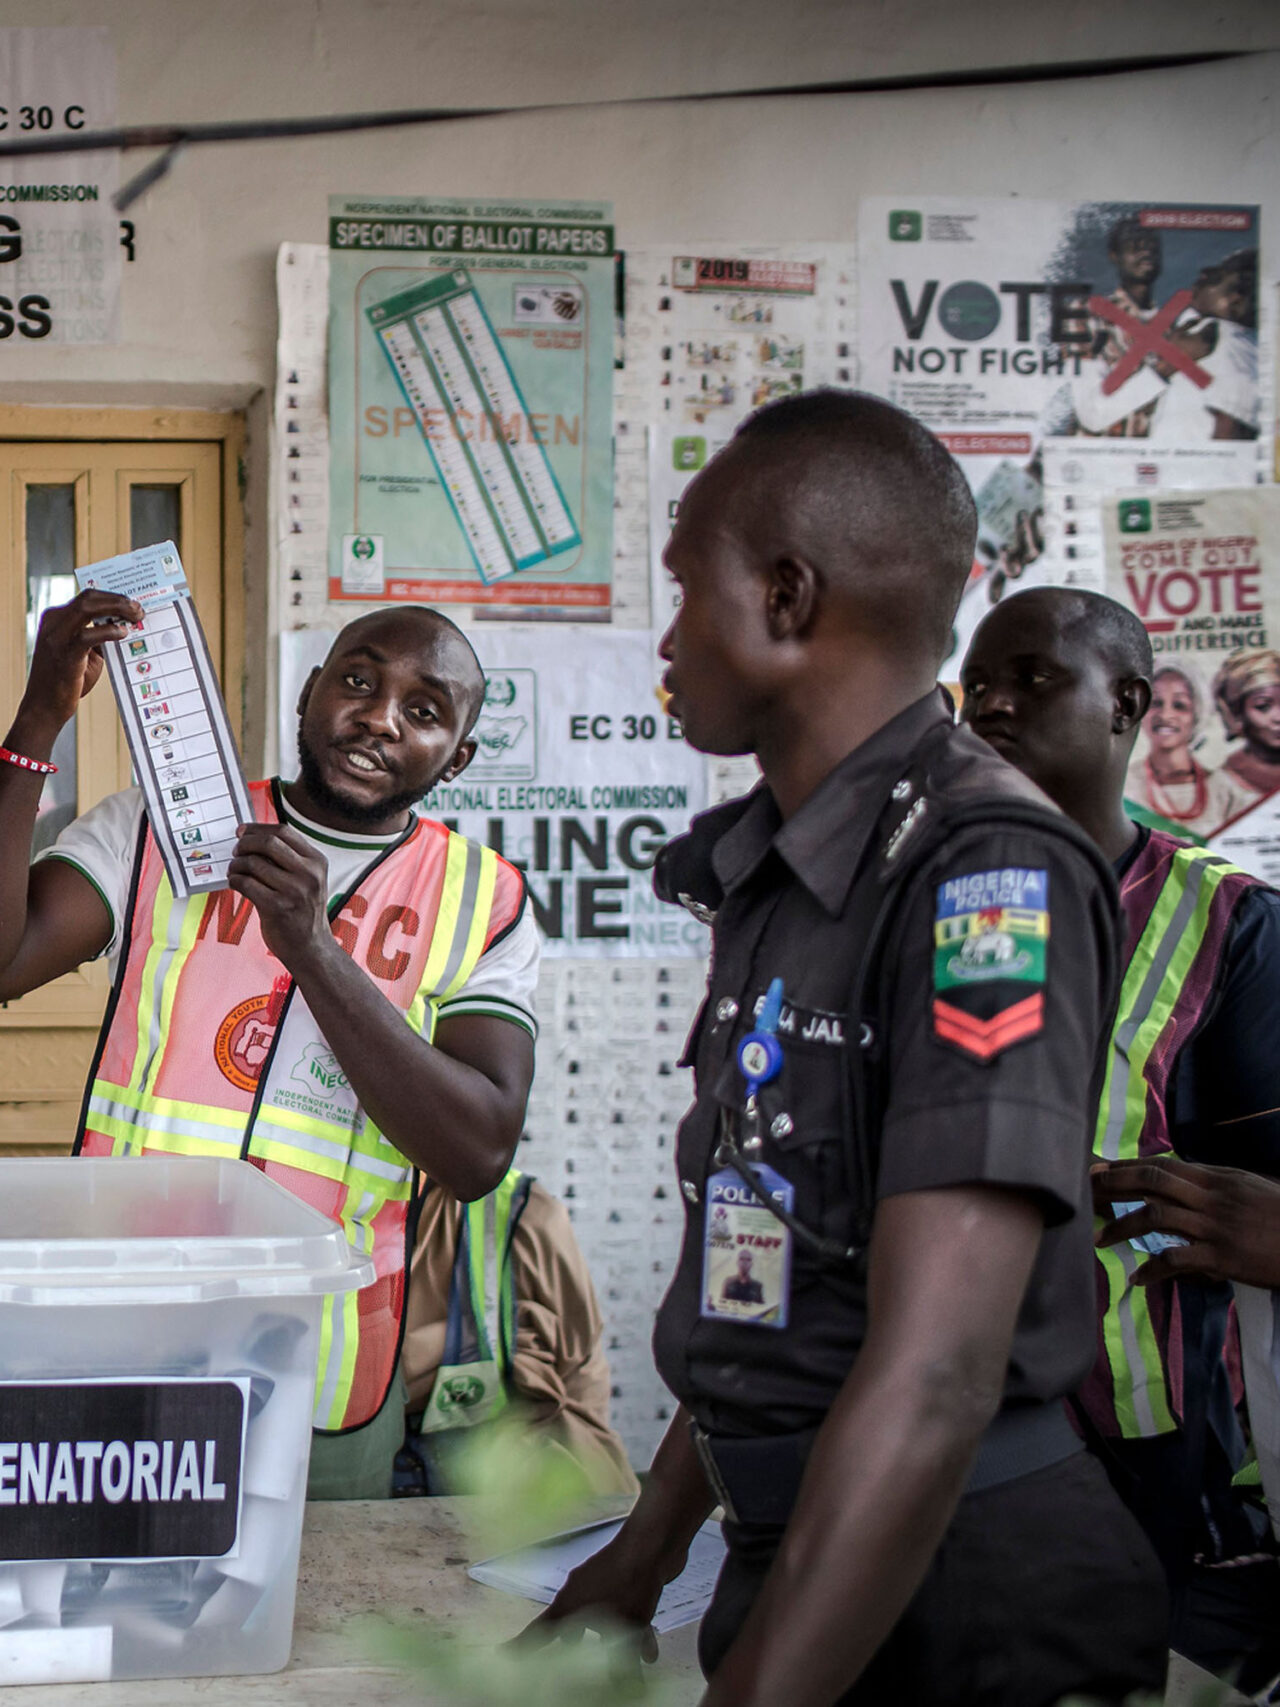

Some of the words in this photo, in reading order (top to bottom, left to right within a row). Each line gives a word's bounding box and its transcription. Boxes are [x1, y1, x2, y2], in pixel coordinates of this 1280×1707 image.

[19, 107, 53, 130] 30
[64, 105, 85, 129] C
[345, 203, 418, 215] INDEPENDENT
[421, 205, 469, 216] NATIONAL
[474, 206, 533, 218] ELECTORAL
[538, 208, 603, 220] COMMISSION
[336, 222, 428, 246] SPECIMEN
[432, 225, 457, 247] OF
[462, 226, 533, 249] BALLOT
[536, 229, 607, 252] PAPERS
[474, 258, 528, 269] GENERAL
[530, 260, 588, 271] ELECTIONS
[700, 261, 748, 280] 2019
[893, 347, 967, 374] NOT
[980, 347, 1085, 375] FIGHT
[364, 406, 579, 447] SPECIMEN
[1180, 539, 1198, 549] OF
[1122, 550, 1192, 570] COME
[1125, 567, 1263, 617] VOTE
[1183, 617, 1215, 630] AND
[1220, 614, 1264, 628] MAKE
[1153, 630, 1267, 653] DIFFERENCE
[570, 715, 611, 740] EC
[622, 715, 656, 740] 30
[420, 788, 493, 811] NATIONAL
[498, 787, 587, 810] ELECTORAL
[591, 785, 688, 808] COMMISSION
[945, 869, 1040, 900] NIGERIA
[527, 877, 630, 938] NE
[955, 888, 1024, 913] POLICE
[231, 1000, 263, 1020] YOUTH
[310, 1061, 348, 1088] INEC
[273, 1096, 323, 1117] ELECTORAL
[276, 1088, 335, 1110] INDEPENDENT
[736, 1233, 783, 1249] STAFF
